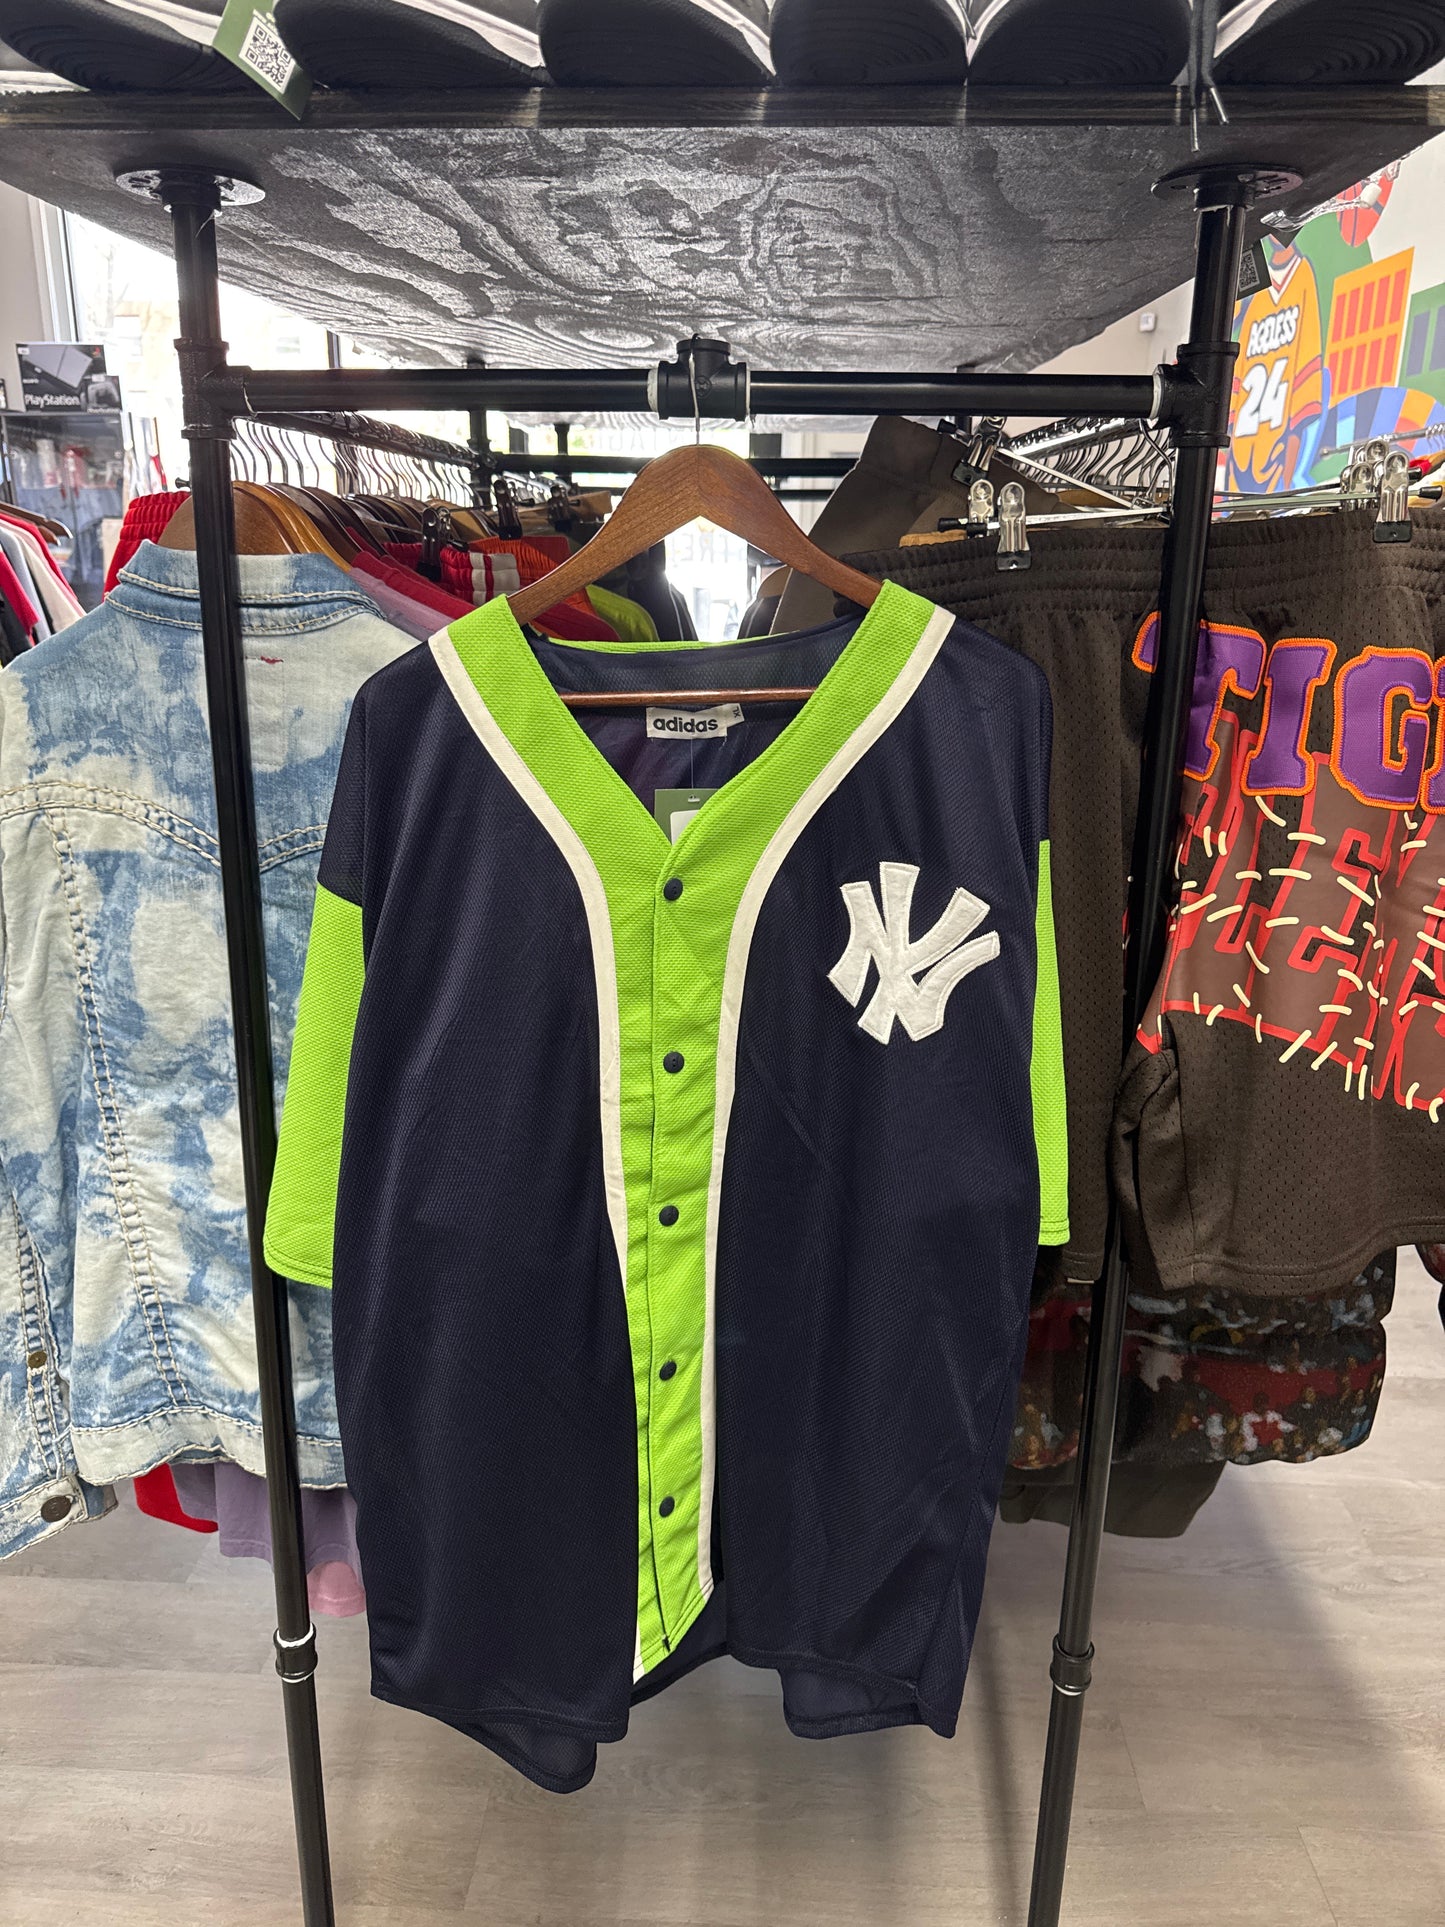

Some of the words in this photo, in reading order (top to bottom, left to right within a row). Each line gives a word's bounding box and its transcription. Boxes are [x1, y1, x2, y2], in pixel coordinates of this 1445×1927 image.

[24, 394, 80, 408] PlayStation
[1234, 357, 1289, 437] 24
[653, 717, 718, 732] adidas
[1132, 611, 1445, 814] TIG
[826, 862, 1001, 1046] NY
